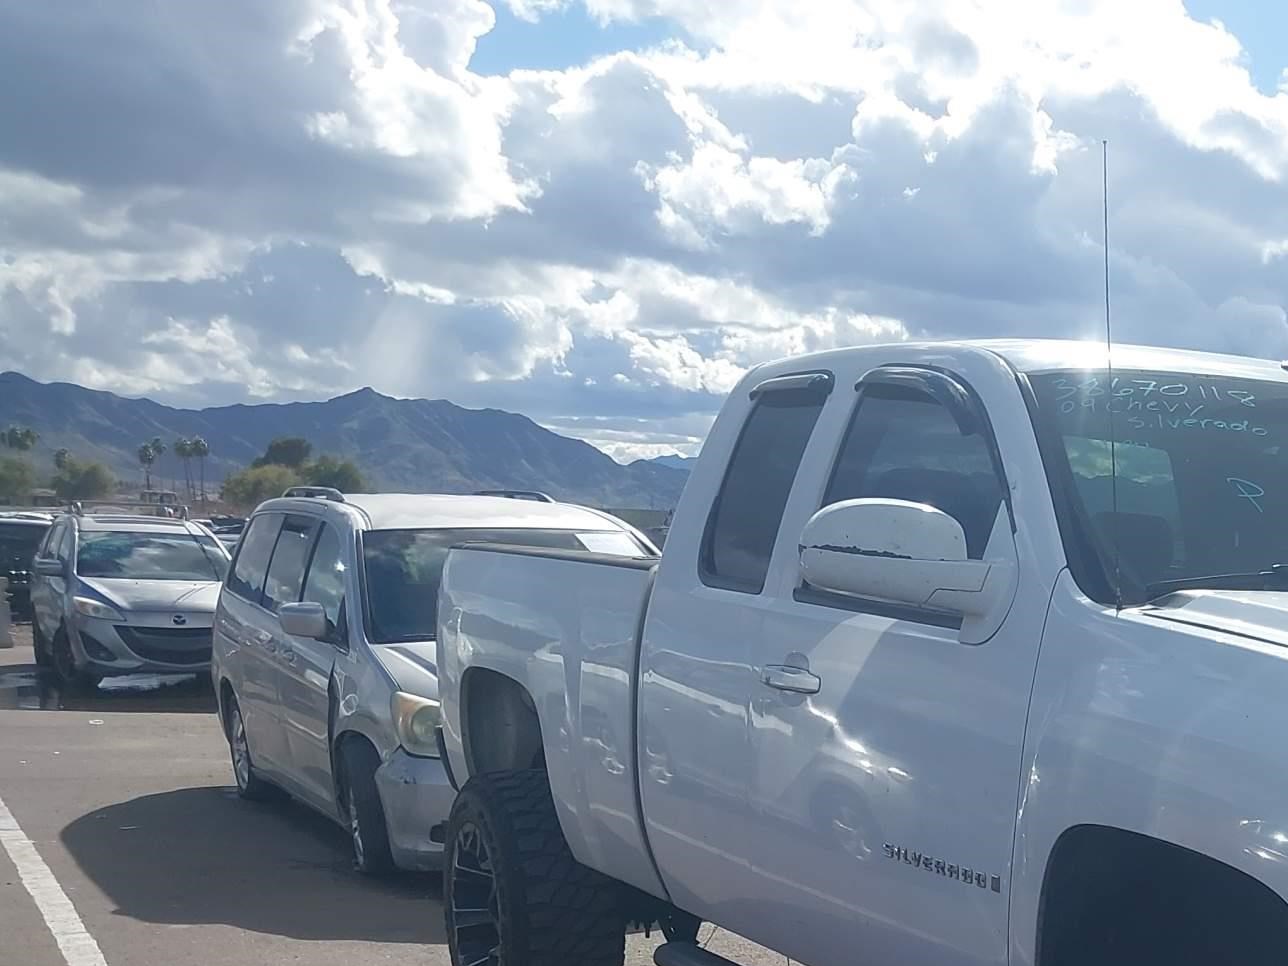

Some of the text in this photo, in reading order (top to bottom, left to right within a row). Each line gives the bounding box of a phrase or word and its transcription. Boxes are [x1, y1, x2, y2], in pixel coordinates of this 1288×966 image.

[1051, 376, 1256, 408] 38670118
[1060, 397, 1205, 417] 09 Chevy
